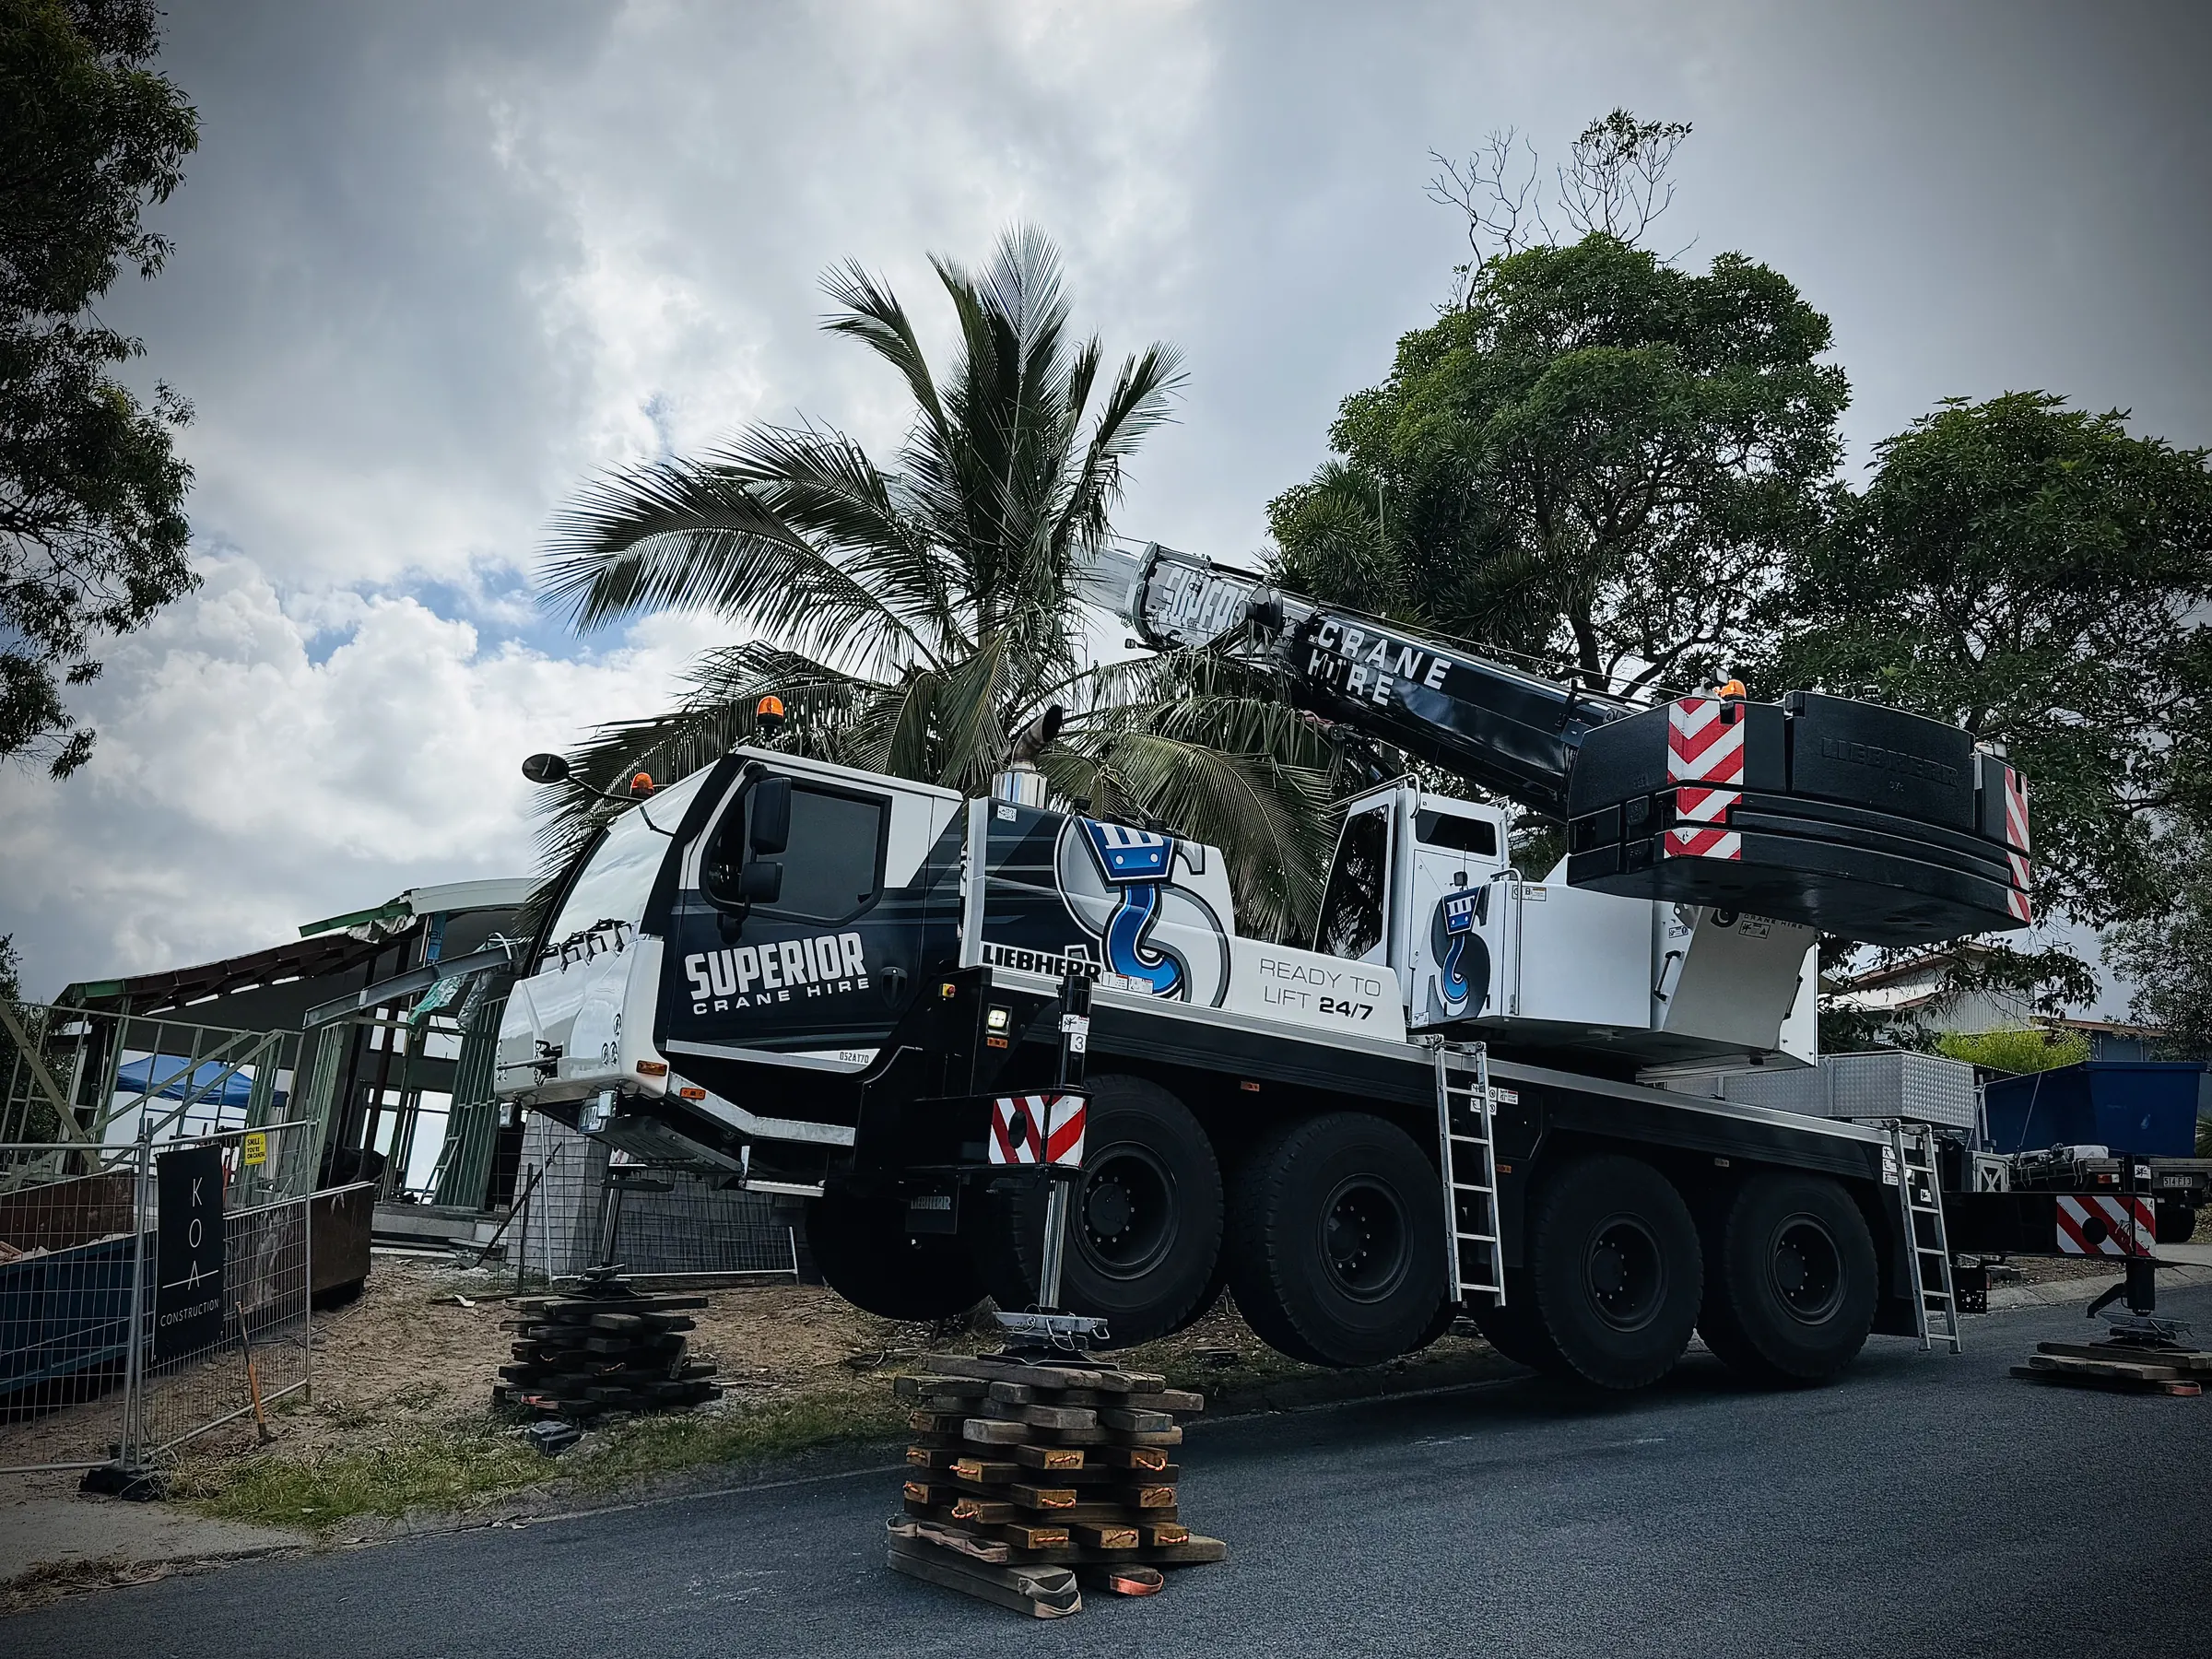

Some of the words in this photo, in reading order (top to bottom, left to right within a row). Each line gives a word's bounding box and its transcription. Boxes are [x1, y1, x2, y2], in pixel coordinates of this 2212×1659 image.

[1159, 566, 1250, 638] SUPER
[1318, 620, 1452, 690] CRANE
[1821, 737, 1959, 788] LIEBHERR
[1744, 913, 1776, 924] CRANE
[684, 932, 867, 1001] SUPERIOR
[982, 944, 1103, 983] LIEBHERR
[1259, 958, 1342, 989] READY
[1349, 975, 1381, 997] TO
[693, 990, 791, 1015] CRANE
[806, 978, 870, 997] HIRE
[1264, 985, 1312, 1009] LIFT
[1318, 996, 1373, 1020] 24/7
[1075, 1036, 1084, 1051] 3
[159, 1298, 219, 1327] CONSTRUCTION
